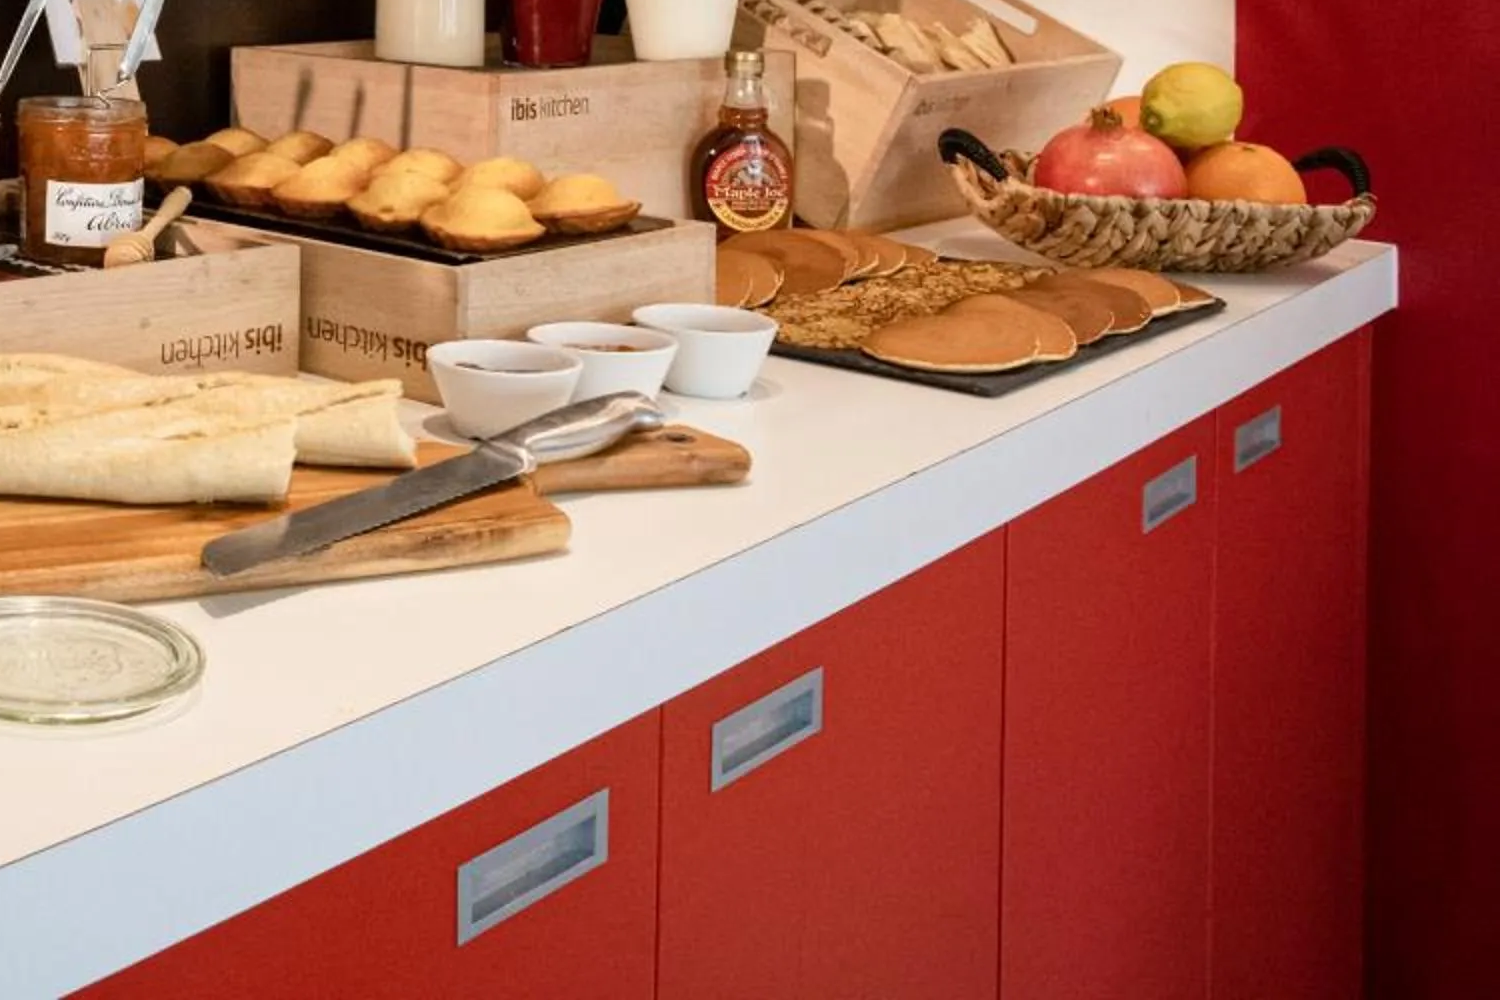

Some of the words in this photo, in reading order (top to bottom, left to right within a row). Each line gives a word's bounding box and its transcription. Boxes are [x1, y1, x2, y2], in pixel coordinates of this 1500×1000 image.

[511, 97, 537, 121] ibis
[539, 94, 590, 119] kitchen
[161, 328, 240, 367] kitchen
[244, 323, 283, 355] ibis
[307, 316, 389, 361] kitchen
[393, 337, 429, 371] bis
